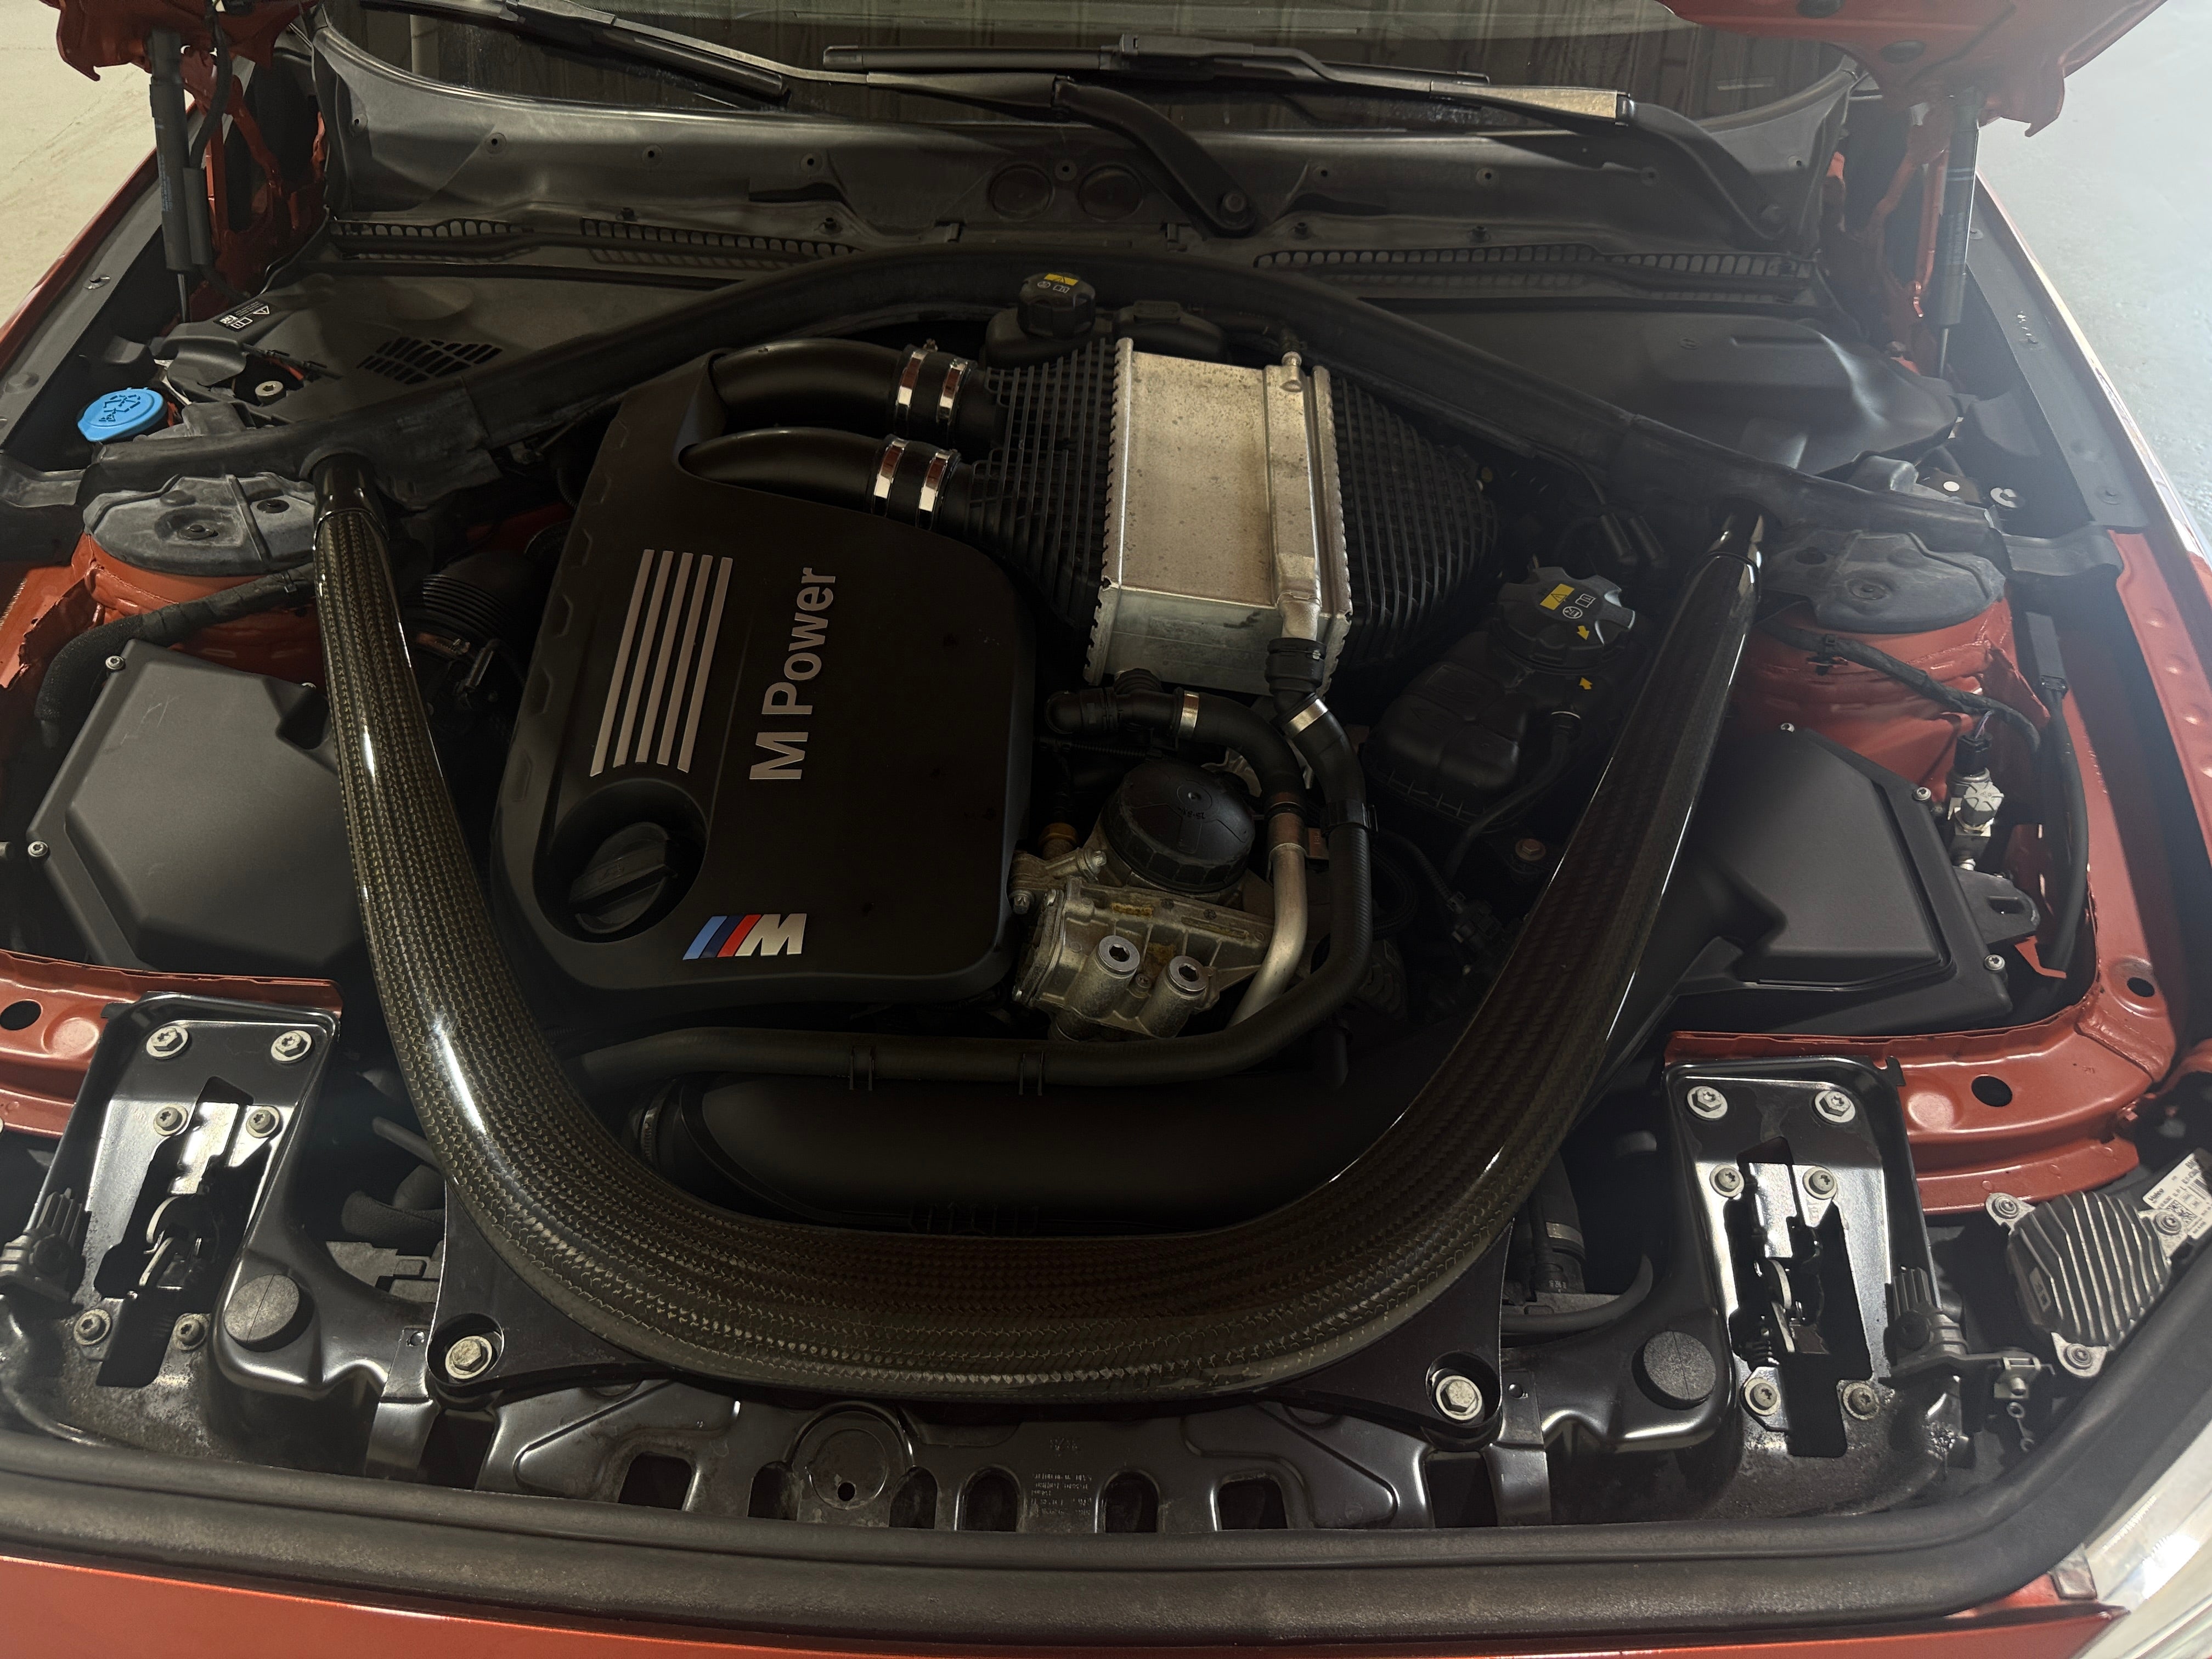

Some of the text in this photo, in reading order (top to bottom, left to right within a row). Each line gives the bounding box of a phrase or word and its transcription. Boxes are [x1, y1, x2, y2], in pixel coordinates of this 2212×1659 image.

[749, 567, 836, 780] M Power
[735, 913, 807, 957] M
[2147, 1188, 2164, 1201] Valeo
